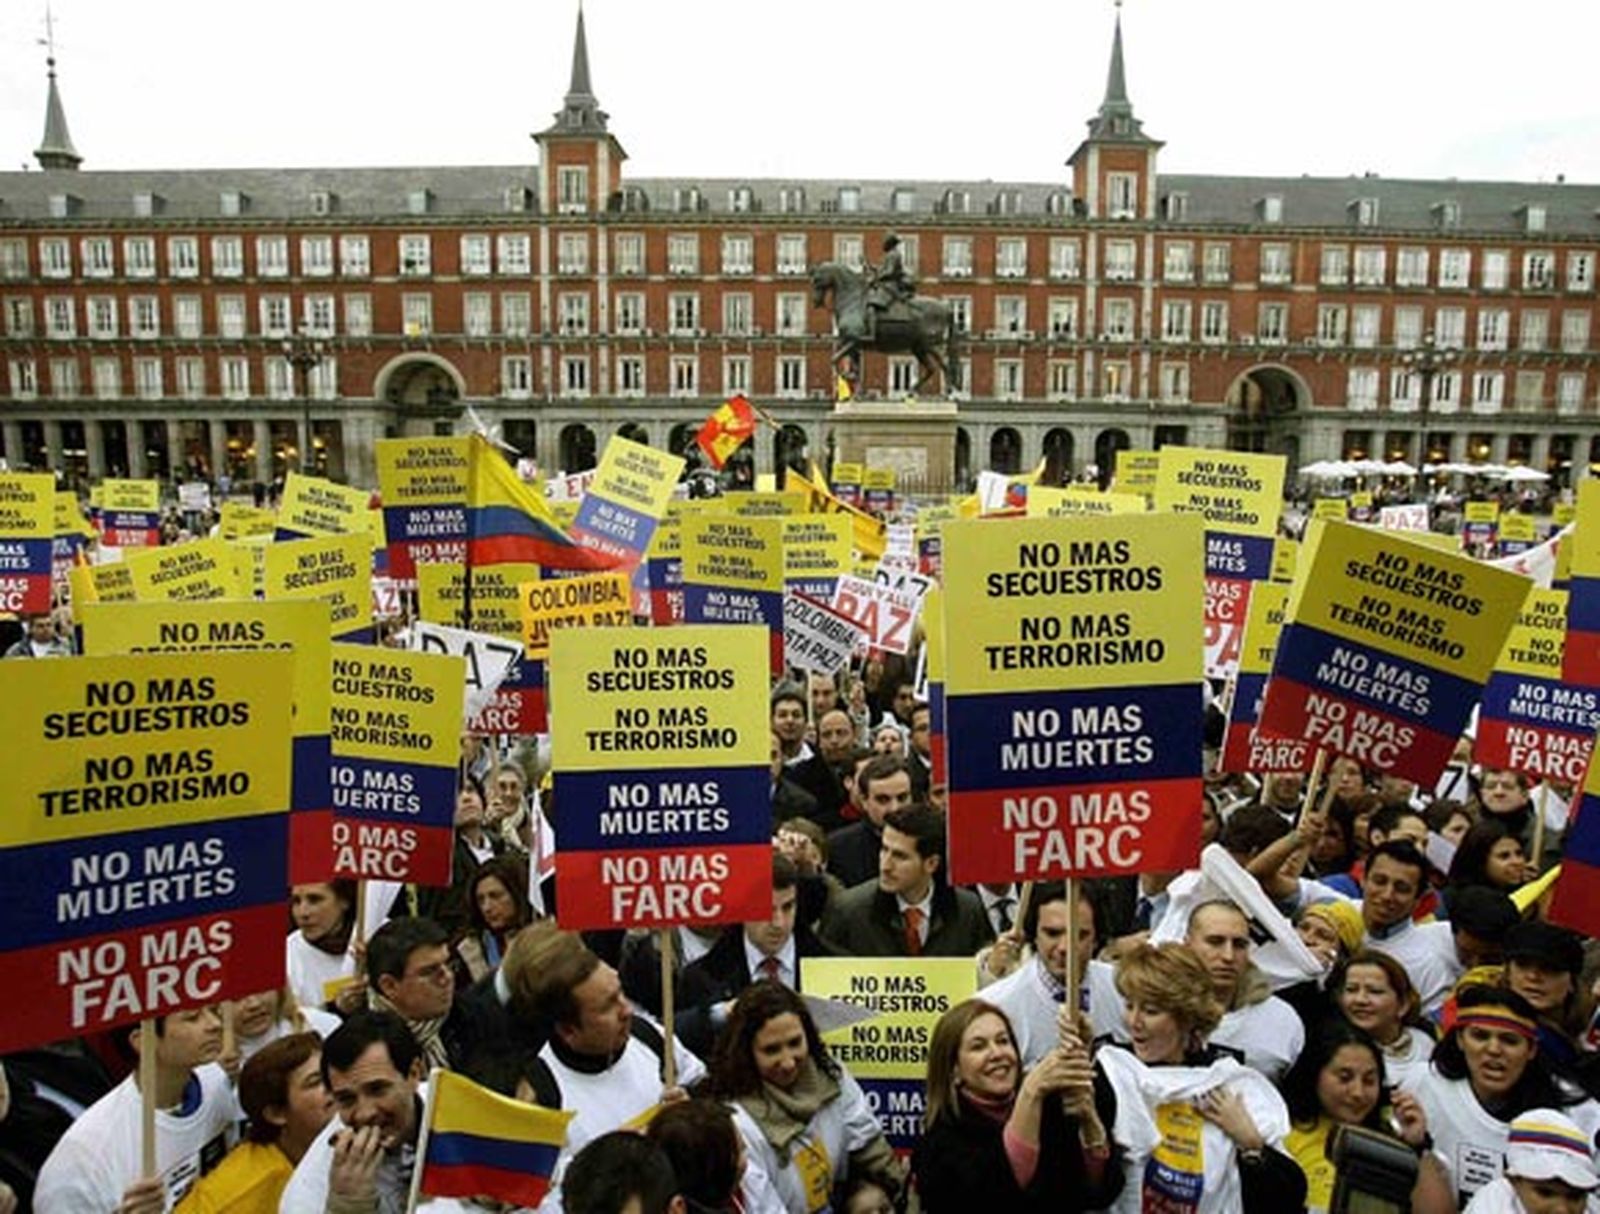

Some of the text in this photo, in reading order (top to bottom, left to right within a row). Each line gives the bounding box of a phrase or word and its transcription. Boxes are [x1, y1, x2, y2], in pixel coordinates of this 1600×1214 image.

[1177, 471, 1262, 491] SECUESTROS
[1194, 461, 1247, 477] NO MAS
[1173, 504, 1258, 525] ORISMO
[1189, 494, 1243, 510] NO MAS
[410, 510, 464, 522] NO MAS
[1384, 508, 1426, 529] PAZ
[297, 548, 343, 569] NO MAS
[409, 543, 431, 558] NO
[1019, 540, 1130, 568] NO MAS
[1207, 539, 1242, 556] MAS
[1207, 555, 1247, 572] RTES
[1375, 550, 1465, 591] NO MAS
[438, 586, 519, 599] SECESTROS
[987, 566, 1162, 597] SECUESTROS
[1345, 561, 1483, 617] SECUESTROS
[707, 591, 760, 609] NO MAS
[1534, 601, 1558, 616] NO
[836, 592, 912, 652] PAZ
[1020, 613, 1130, 641] NO MAS
[1358, 595, 1447, 635] NO MAS
[161, 622, 265, 643] NO MAS
[1329, 603, 1465, 660] TERRORISMO
[1530, 638, 1554, 652] NO
[614, 648, 707, 668] NO MAS
[985, 638, 1165, 671] TERRORISMO
[1510, 648, 1560, 667] TERRO
[333, 660, 412, 683] NO MAS
[587, 669, 734, 692] SECUESTROS
[1332, 647, 1430, 695] NO MAS
[86, 677, 216, 707] NO MAS
[333, 678, 434, 704] CUESTROS
[1316, 663, 1430, 716] MUERTES
[1518, 683, 1597, 710] NO MAS
[43, 702, 250, 740] SECUESTROS
[331, 707, 410, 729] NO MAS
[468, 709, 520, 730] ARC
[615, 706, 708, 728] NO MAS
[1012, 704, 1143, 738] NO MAS
[1305, 693, 1347, 723] NO
[1352, 709, 1416, 748] MAS
[1509, 698, 1600, 728] MUERTES
[331, 725, 433, 750] RRORISMO
[585, 728, 737, 751] TERRORISMO
[1304, 716, 1398, 769] FARC
[1506, 727, 1539, 748] NO
[85, 749, 214, 784] NO MAS
[1001, 736, 1153, 771] MUERTES
[1249, 745, 1306, 769] FARC
[1509, 746, 1587, 780] FARC
[363, 769, 414, 793] MAS
[38, 772, 250, 818] TERRORISMO
[333, 788, 421, 814] UERTES
[609, 782, 719, 809] NO MAS
[600, 808, 730, 836] MUERTES
[1003, 789, 1151, 831] NO MAS
[333, 822, 417, 851] O MAS
[1014, 824, 1142, 874] FARC
[71, 838, 225, 888] NO MAS
[333, 844, 409, 877] ARC
[602, 853, 729, 885] NO MAS
[56, 868, 237, 923] MUERTES
[612, 882, 722, 922] FARC
[57, 920, 234, 985] NO MAS
[70, 956, 223, 1029] FARC
[851, 976, 926, 993] NO MAS
[852, 1026, 927, 1043] NO MAS
